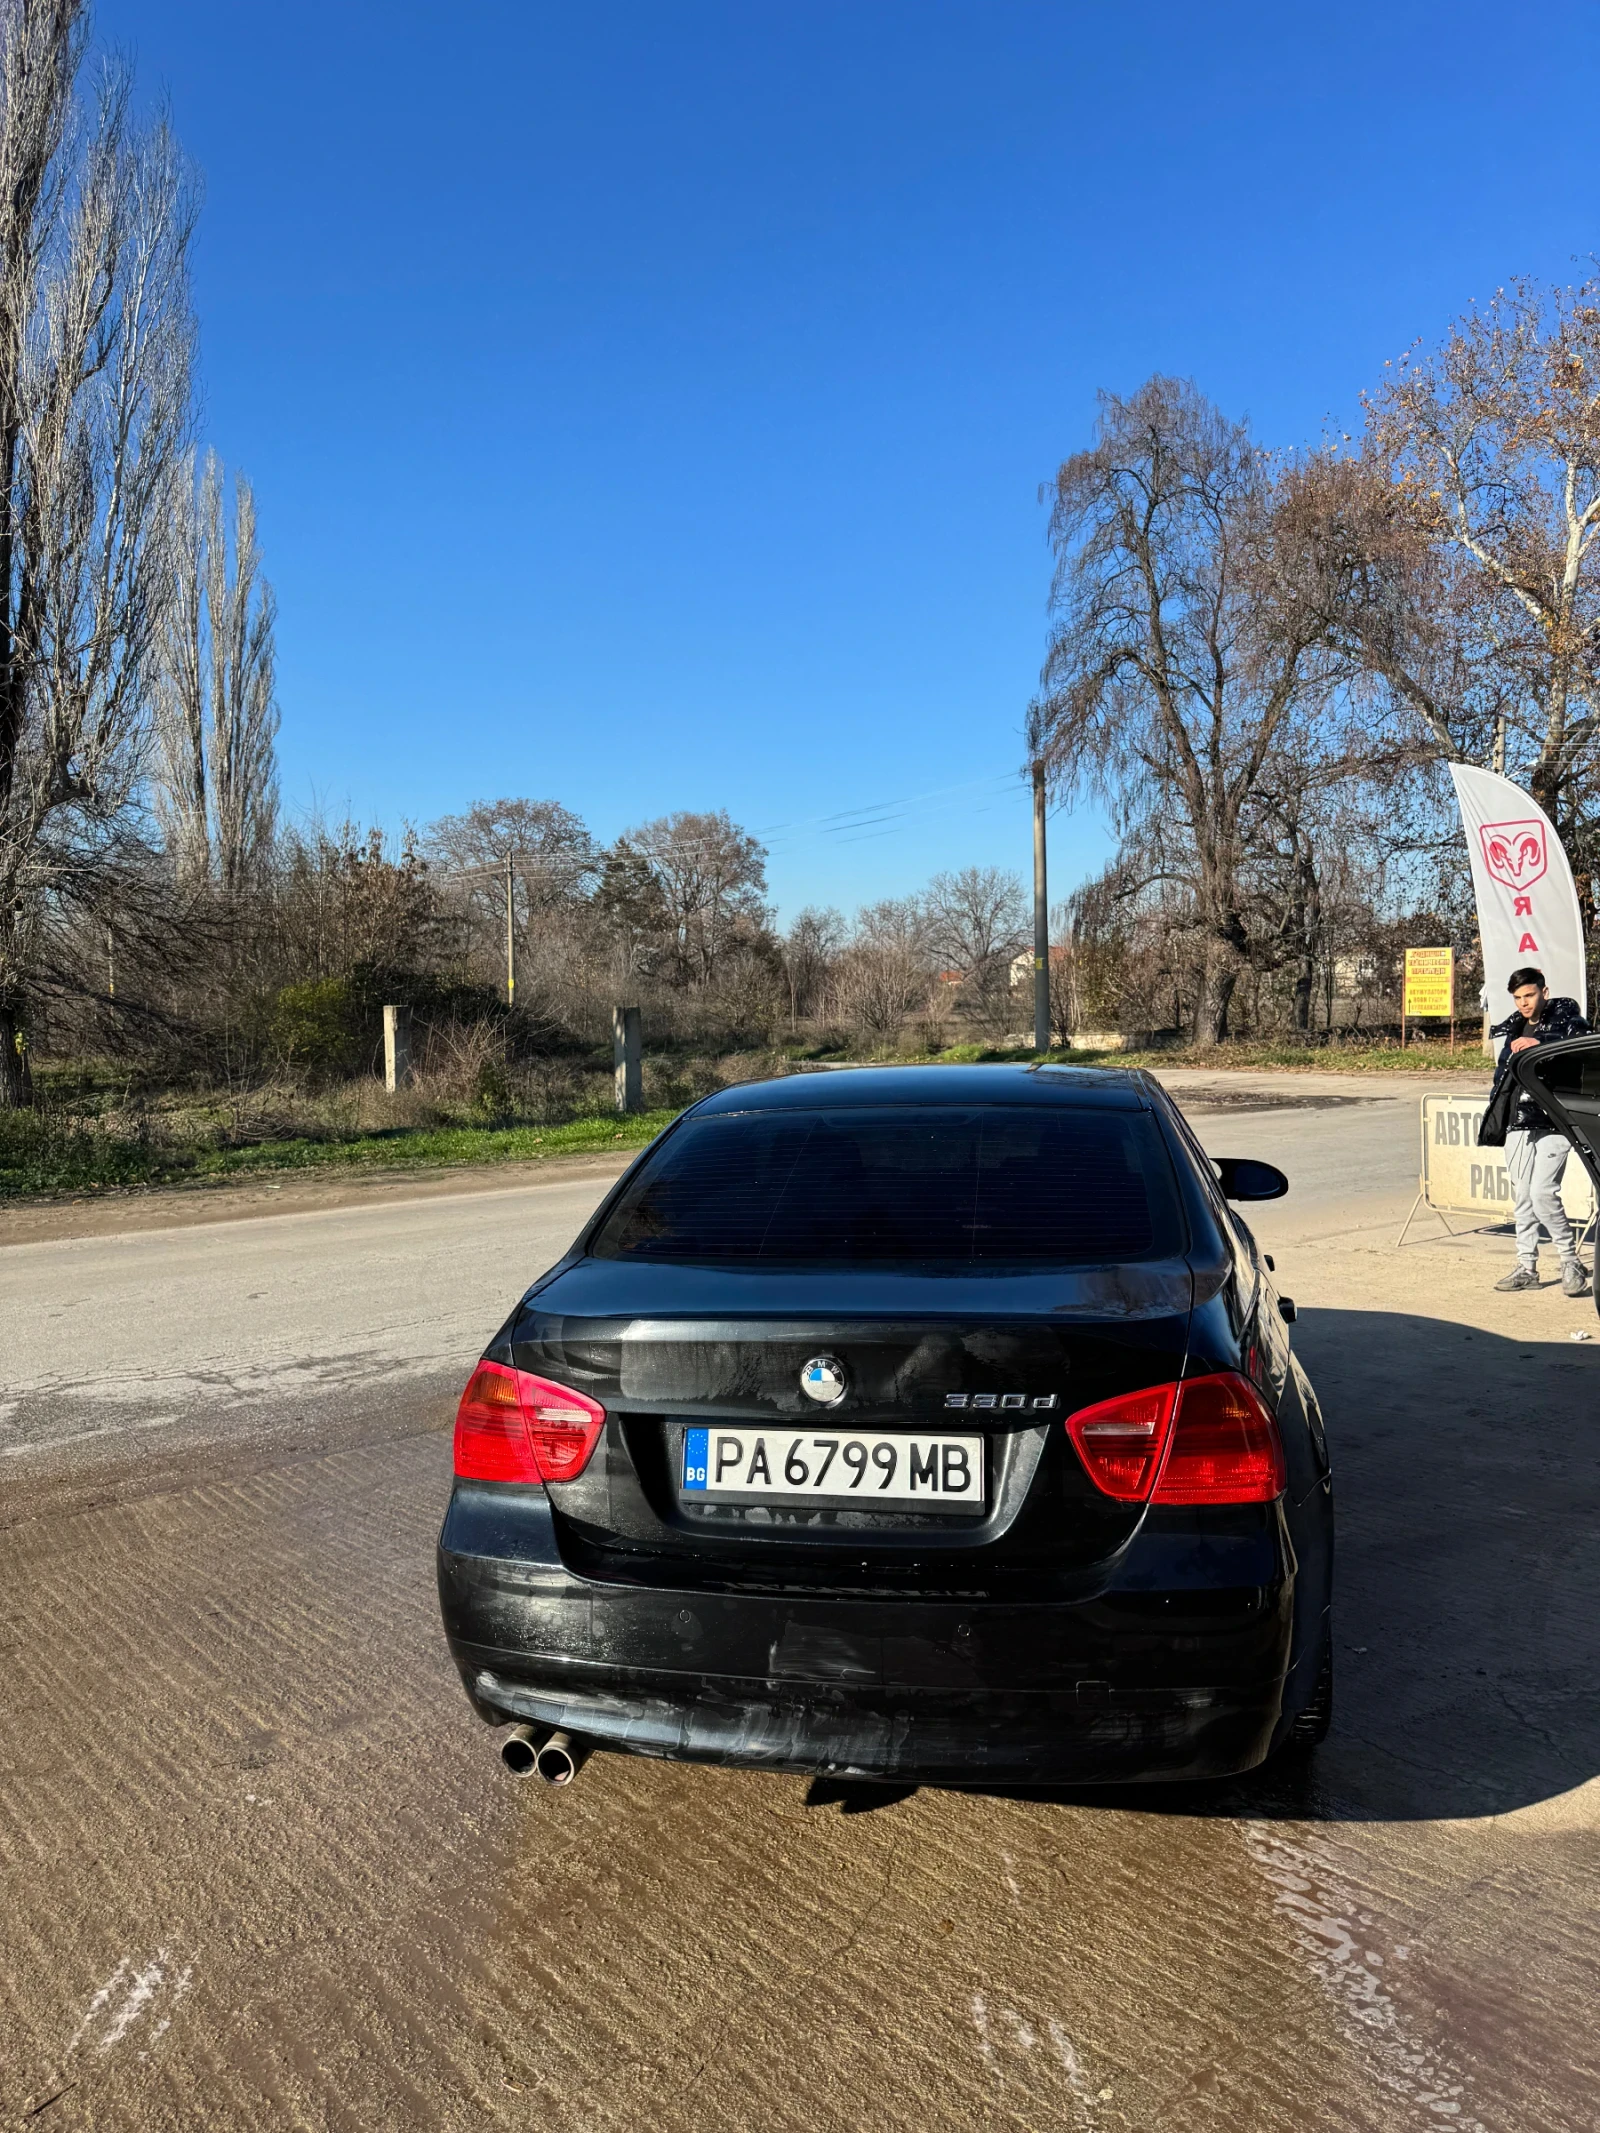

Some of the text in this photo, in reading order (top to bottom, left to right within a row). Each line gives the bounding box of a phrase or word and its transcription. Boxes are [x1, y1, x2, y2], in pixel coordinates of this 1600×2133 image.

[1470, 1164, 1516, 1201] РАБ
[803, 1361, 840, 1376] BMW
[944, 1393, 1058, 1409] 330d
[715, 1436, 971, 1493] PA 6799 MB
[686, 1466, 706, 1482] BG
